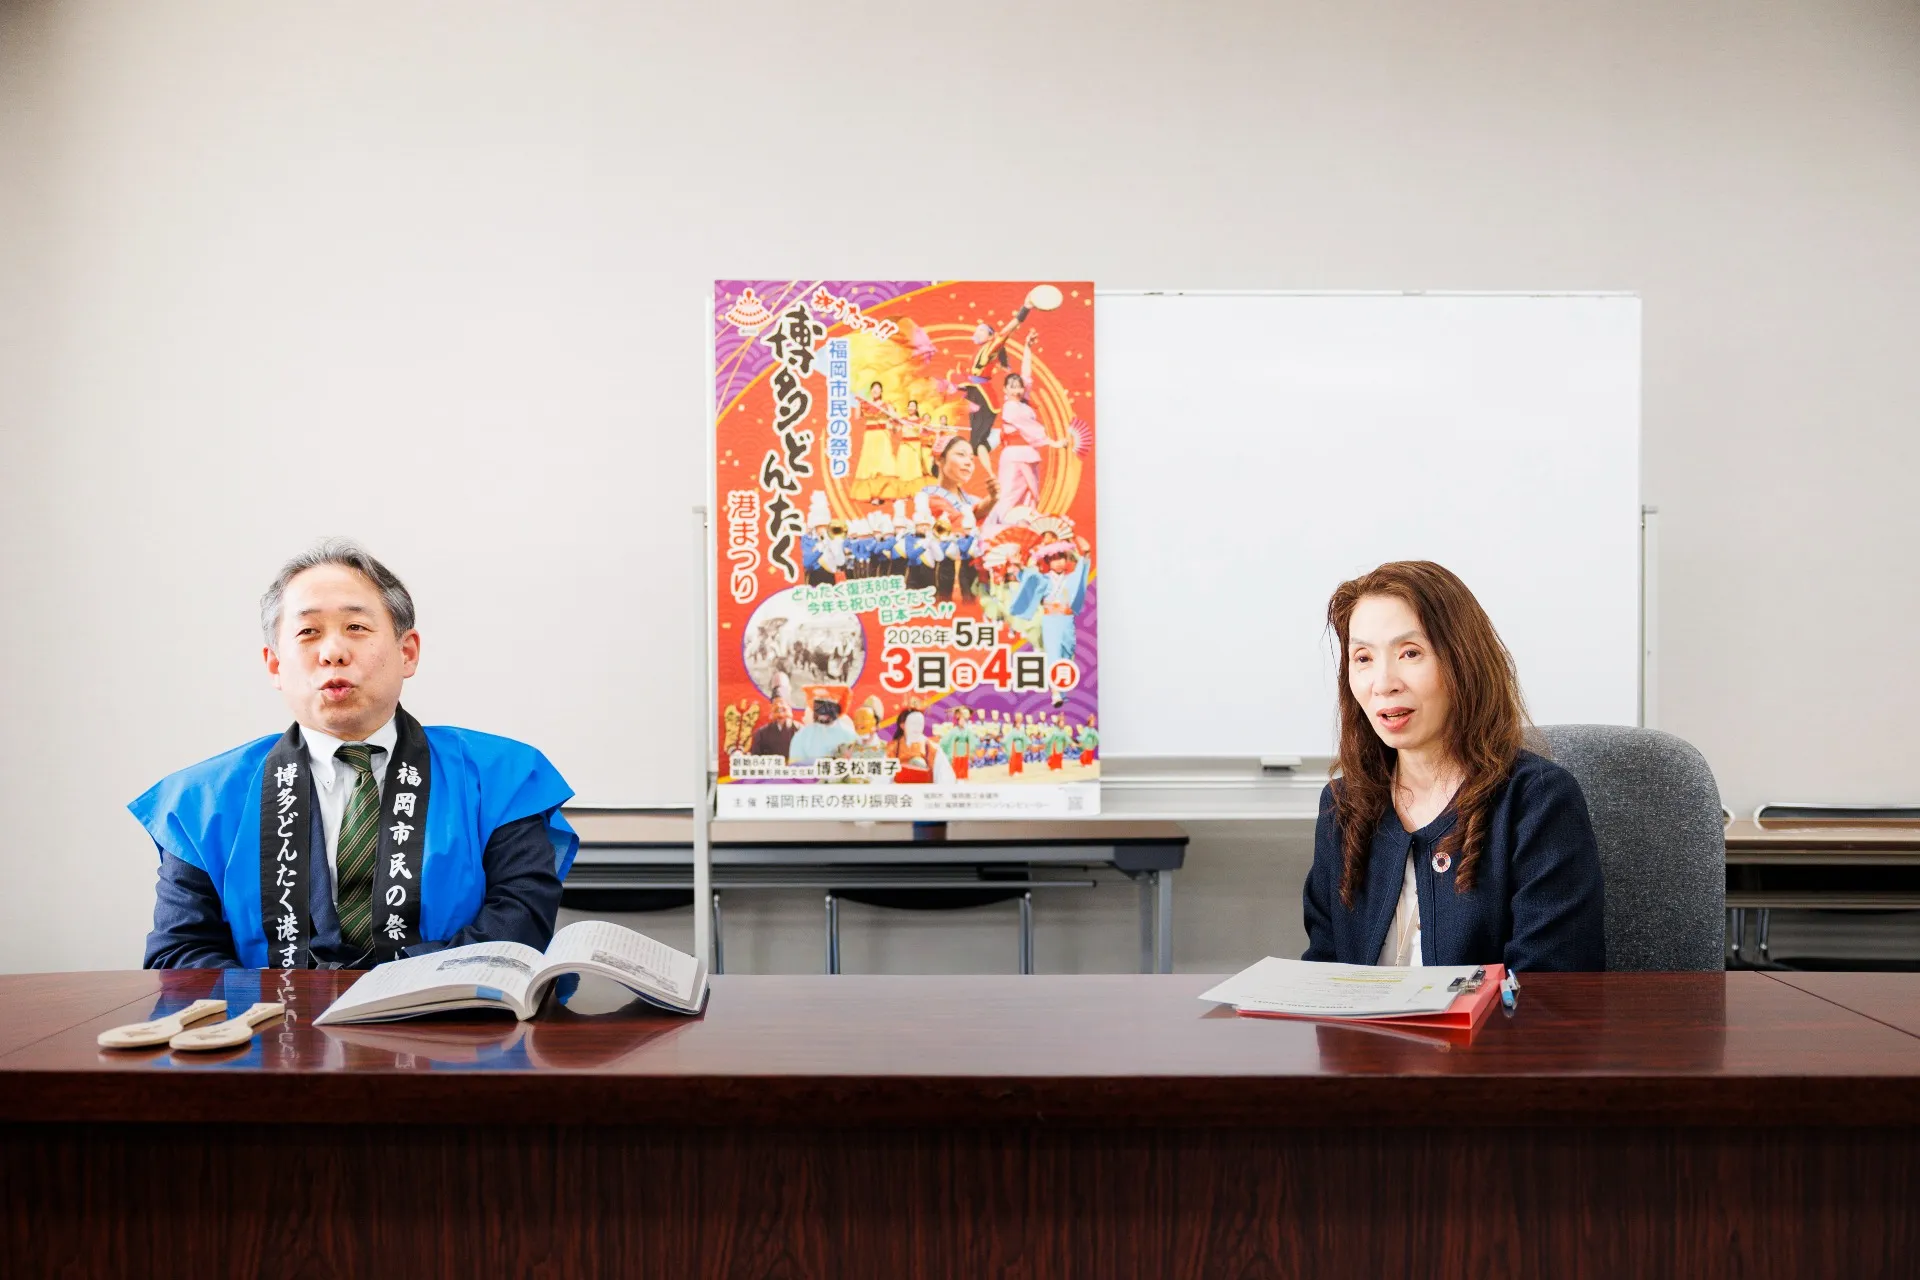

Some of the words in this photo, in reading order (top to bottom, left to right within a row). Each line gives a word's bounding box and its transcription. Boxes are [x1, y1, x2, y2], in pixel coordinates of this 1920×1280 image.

[764, 304, 823, 580] 博多どんたく
[829, 341, 849, 476] 福岡市民の祭り
[729, 493, 757, 599] 港まつり
[383, 761, 422, 960] 福岡市民の祭
[765, 793, 913, 809] 福岡市民の祭り振興会
